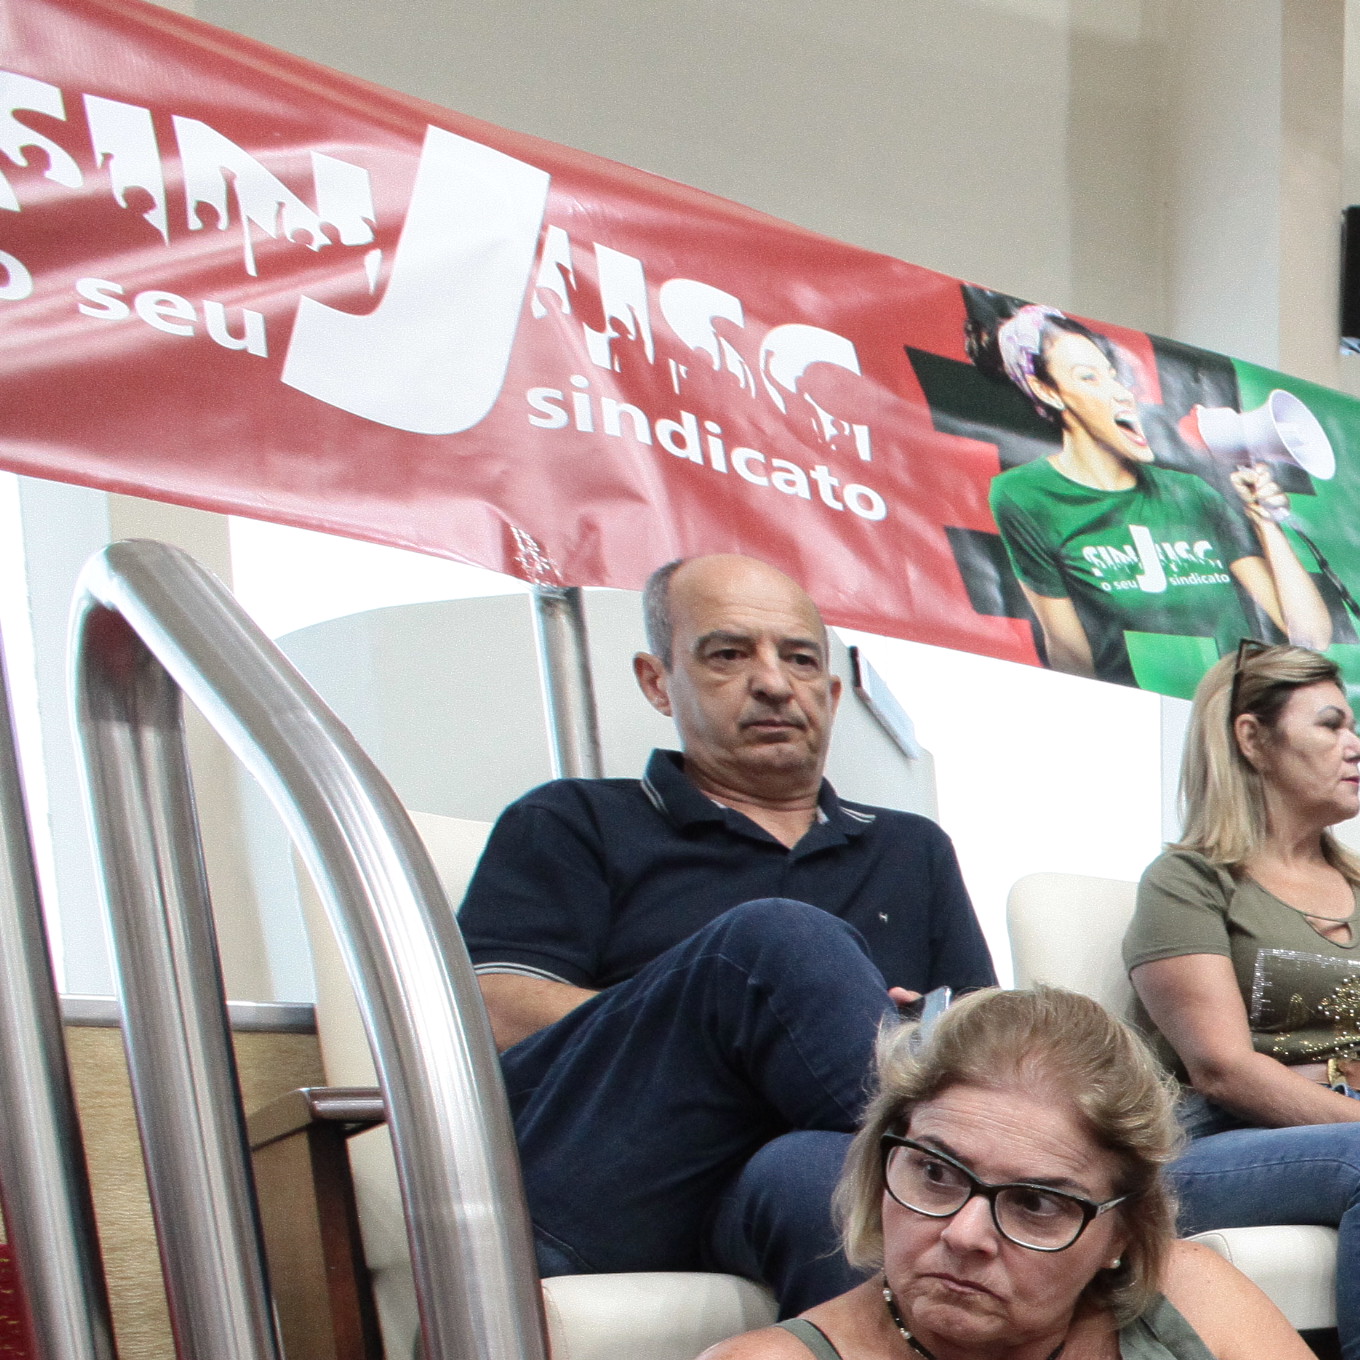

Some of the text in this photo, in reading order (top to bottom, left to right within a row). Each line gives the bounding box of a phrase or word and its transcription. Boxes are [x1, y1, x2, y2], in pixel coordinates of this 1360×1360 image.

[75, 277, 268, 358] seu
[525, 375, 888, 523] sindicato
[1101, 573, 1231, 591] o seu sindicato
